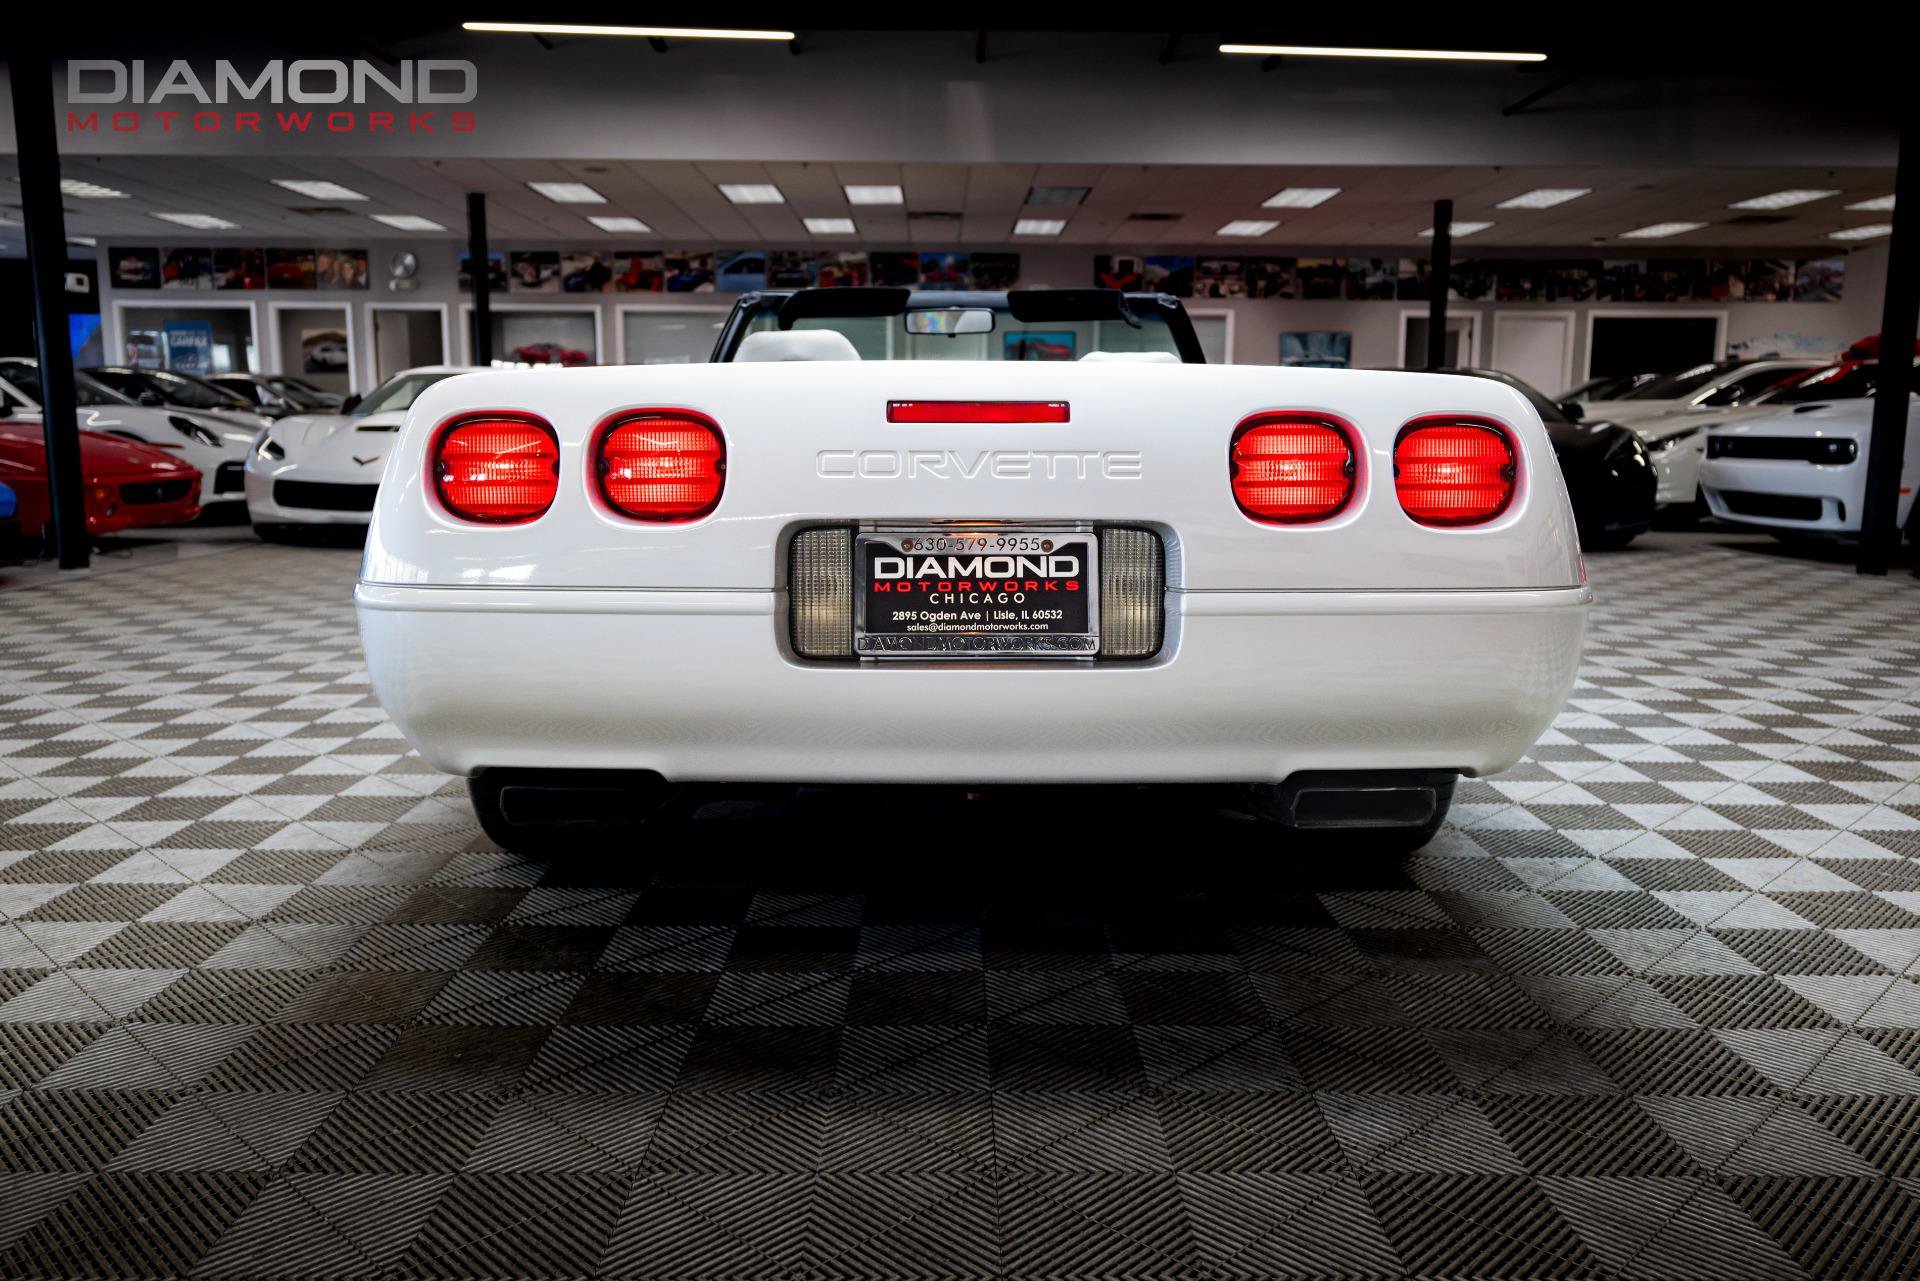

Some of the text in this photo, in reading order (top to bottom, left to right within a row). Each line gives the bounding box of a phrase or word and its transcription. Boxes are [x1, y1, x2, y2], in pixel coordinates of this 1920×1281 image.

[815, 449, 1143, 479] CORVETTE
[913, 537, 1041, 552] 630-579-9955
[873, 555, 1080, 579] DIAMOND
[873, 580, 1080, 592] MOTORWORKS
[929, 592, 1026, 604] CHICAGO
[892, 610, 918, 621] 2895
[919, 610, 957, 623] Ogden
[960, 610, 982, 620] Ave
[993, 609, 1019, 621] Lisle,
[1021, 609, 1030, 620] IL
[1032, 609, 1063, 620] 60532
[906, 621, 1049, 632] sales@diamondmotorworks.com
[857, 635, 1096, 651] DAMONDMOTORWORKS.COM
